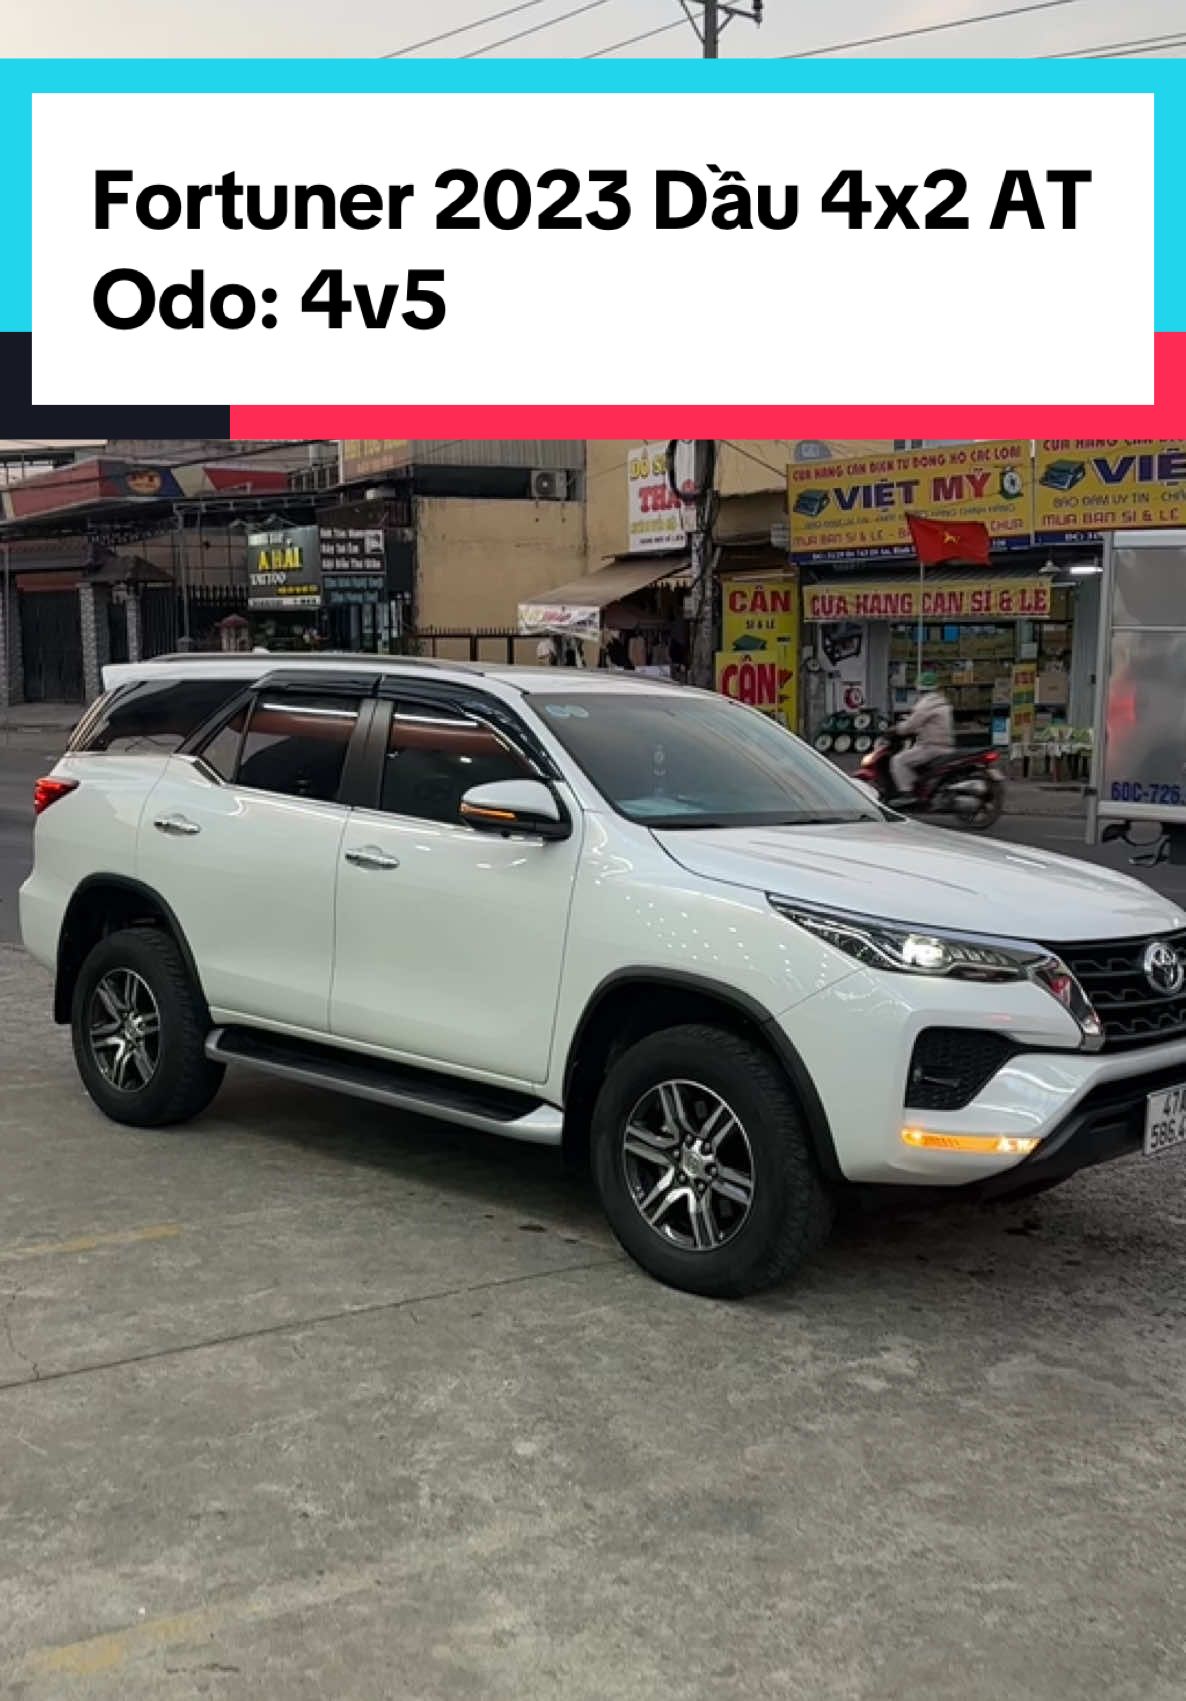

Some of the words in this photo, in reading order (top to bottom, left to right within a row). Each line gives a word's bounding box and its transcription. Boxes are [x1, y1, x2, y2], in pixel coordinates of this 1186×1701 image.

[833, 479, 919, 513] VIỆT
[933, 467, 992, 501] MỸ
[728, 584, 792, 613] CÂN
[1000, 589, 1013, 612] &
